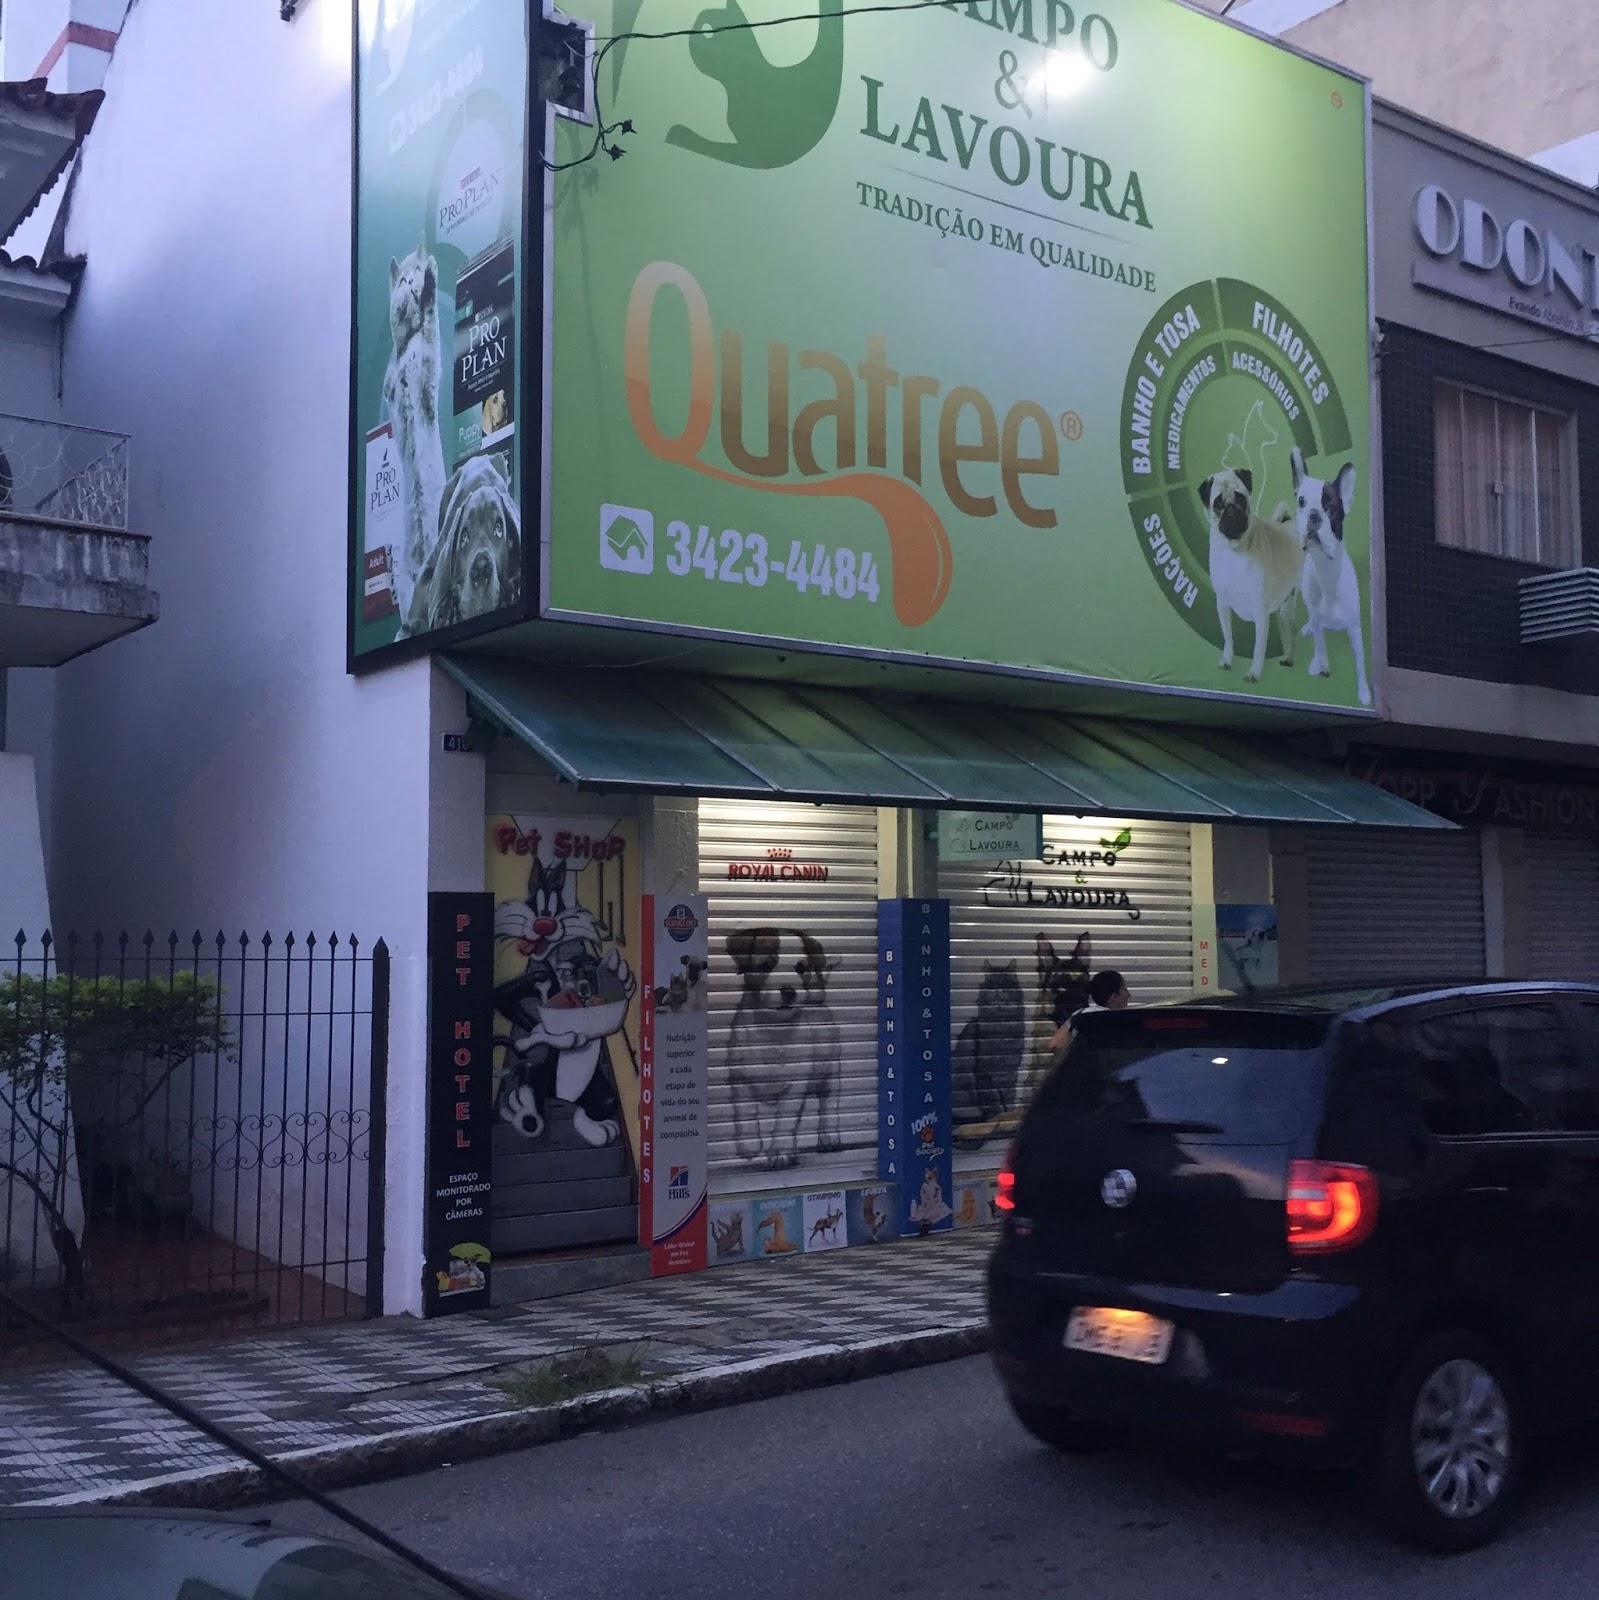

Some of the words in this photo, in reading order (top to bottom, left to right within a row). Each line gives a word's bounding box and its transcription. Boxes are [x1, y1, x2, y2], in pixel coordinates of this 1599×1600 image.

[994, 49, 1033, 118] &
[860, 75, 1153, 230] LAVOURA
[856, 181, 984, 243] TRADIÇÃO
[989, 226, 1025, 256] EM
[1029, 237, 1157, 293] QUALIDADE
[469, 316, 500, 353] PRO
[1155, 304, 1201, 359] TOSA
[461, 336, 507, 383] PLAN
[1146, 351, 1165, 374] E
[1251, 300, 1330, 405] FILHOTES
[1231, 350, 1300, 422] ACESSÓRIOS
[1130, 374, 1157, 475] BANHO
[1167, 354, 1216, 471] MEDICAMENTOS
[375, 467, 397, 491] PRO
[370, 482, 401, 510] PLAN
[666, 520, 880, 604] 3423-4484
[1143, 512, 1199, 609] RAÇÕES
[975, 819, 1014, 831] CAMPO
[496, 827, 541, 854] Pet
[969, 839, 1020, 851] LAVOURA
[1042, 845, 1117, 867] CAMPO
[727, 863, 776, 881] ROYAL
[780, 864, 828, 882] CANIN
[1026, 881, 1131, 906] LAVOURA
[456, 914, 472, 986] PET
[665, 1033, 696, 1044] Nutrição
[675, 1064, 692, 1074] cada
[455, 1021, 472, 1148] HOTEL
[642, 985, 652, 1184] FILHOTES
[665, 1082, 685, 1092] etapa
[686, 1080, 696, 1089] de
[677, 1096, 686, 1105] do
[689, 1112, 697, 1121] de
[436, 1182, 491, 1198] MONITORADO
[449, 1172, 478, 1183] ESPAÇO
[445, 1207, 483, 1221] CÂMERAS
[456, 1197, 472, 1207] POR
